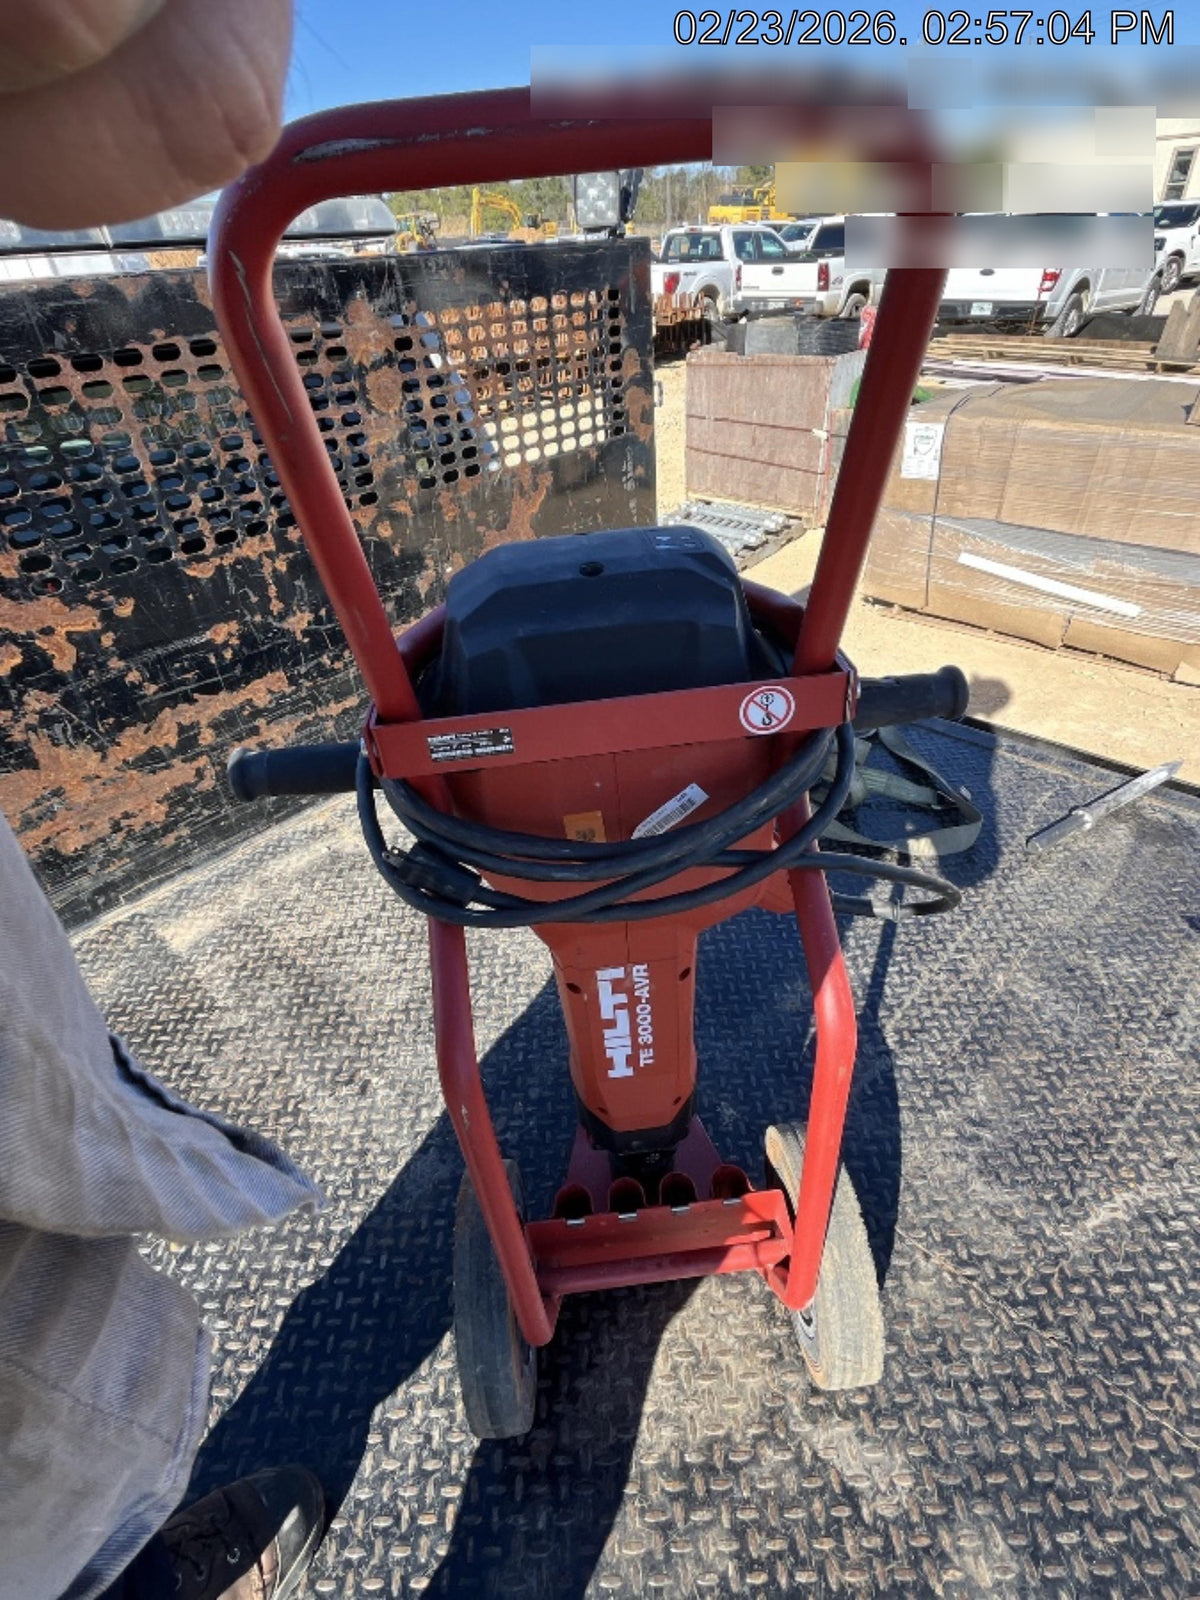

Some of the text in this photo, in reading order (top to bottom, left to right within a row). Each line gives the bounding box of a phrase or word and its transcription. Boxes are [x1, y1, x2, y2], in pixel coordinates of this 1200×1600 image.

[597, 967, 633, 1077] HILTI
[633, 964, 654, 1066] TE 3000-AVR
